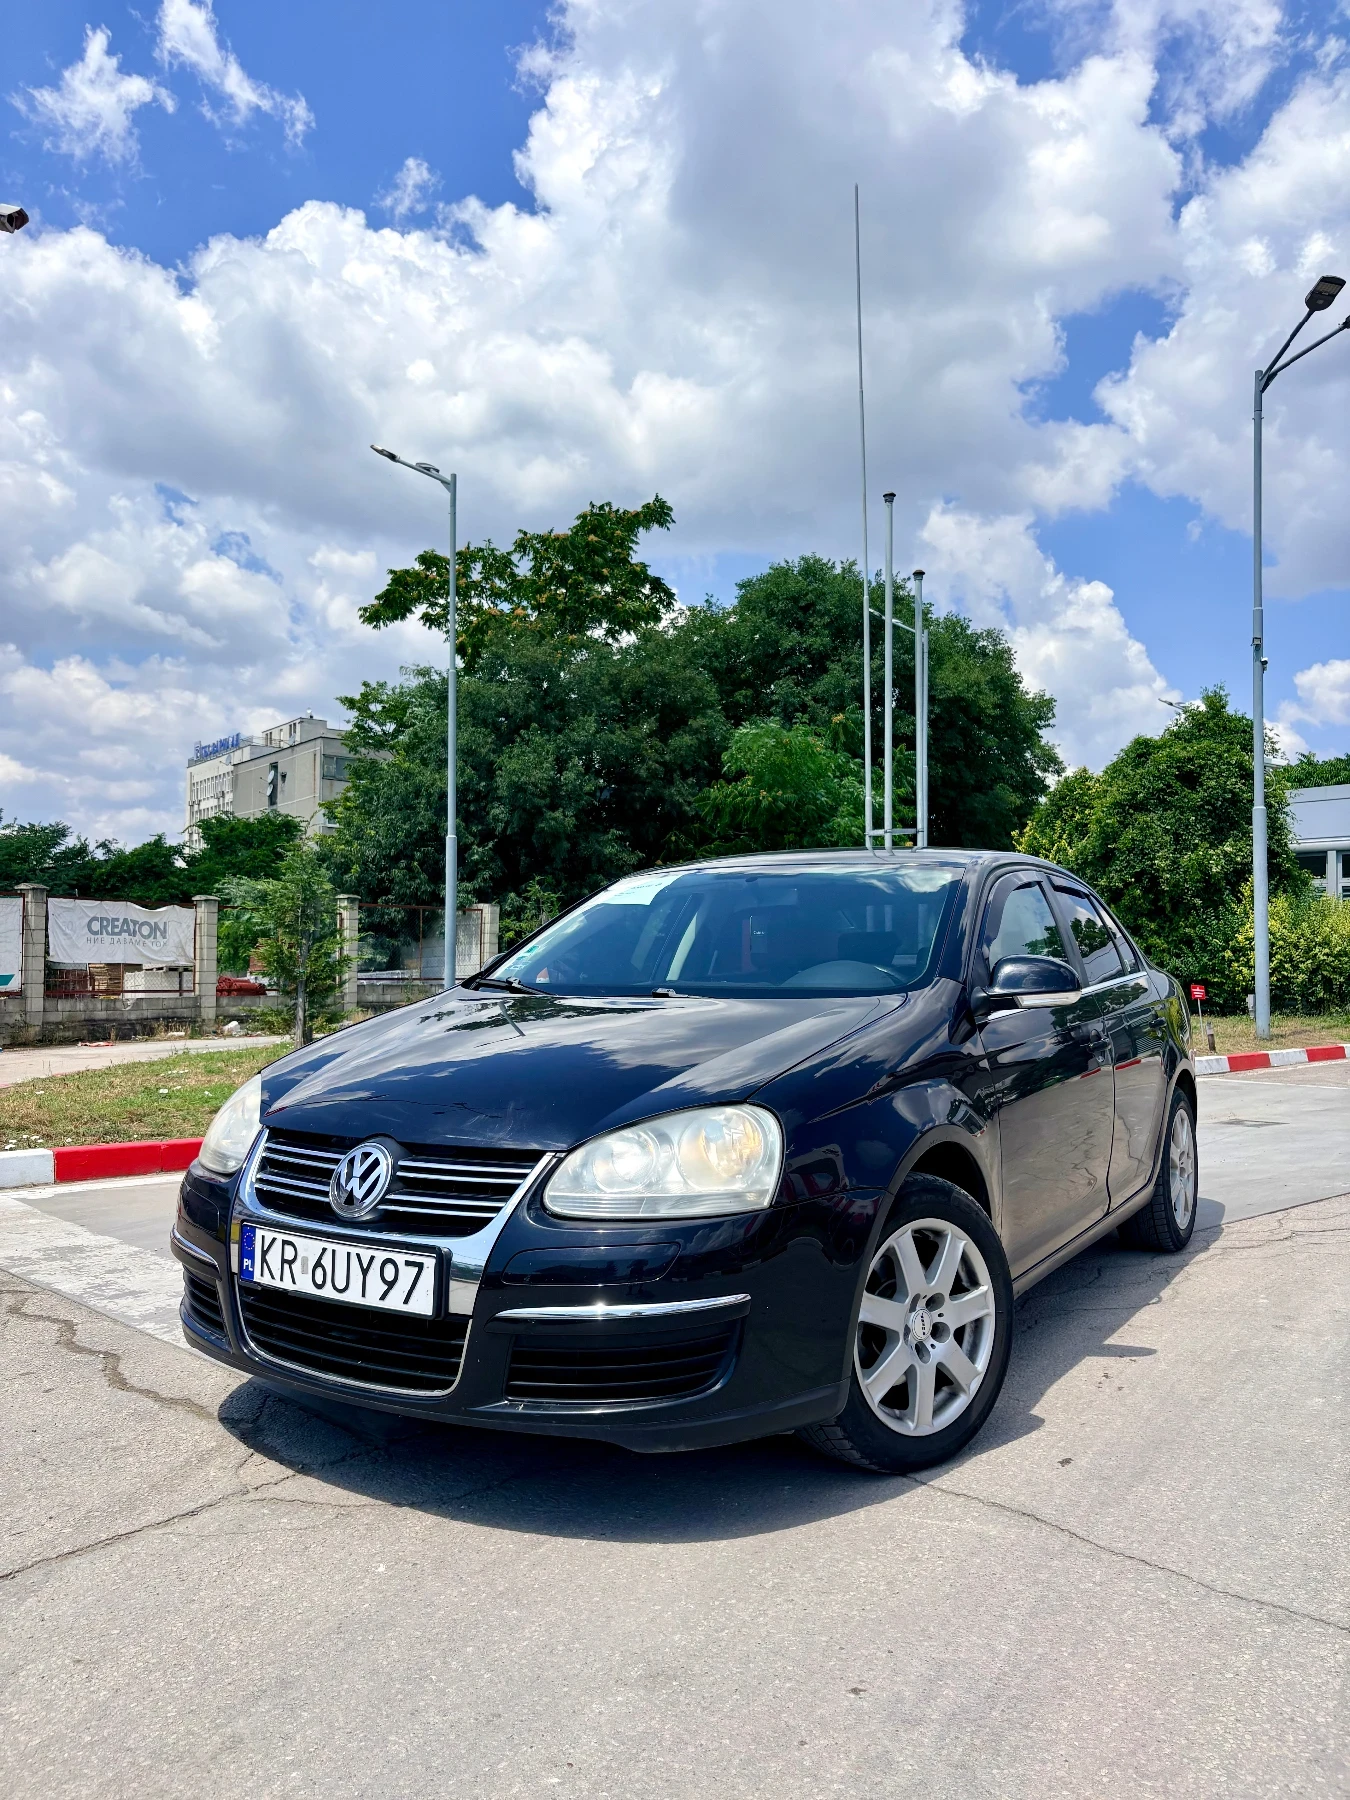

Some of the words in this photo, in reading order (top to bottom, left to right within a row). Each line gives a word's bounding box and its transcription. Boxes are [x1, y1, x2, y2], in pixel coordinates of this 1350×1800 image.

[87, 916, 167, 939] CREATON
[243, 1258, 254, 1272] PL
[260, 1234, 298, 1285] KR
[311, 1246, 425, 1305] 6UY97
